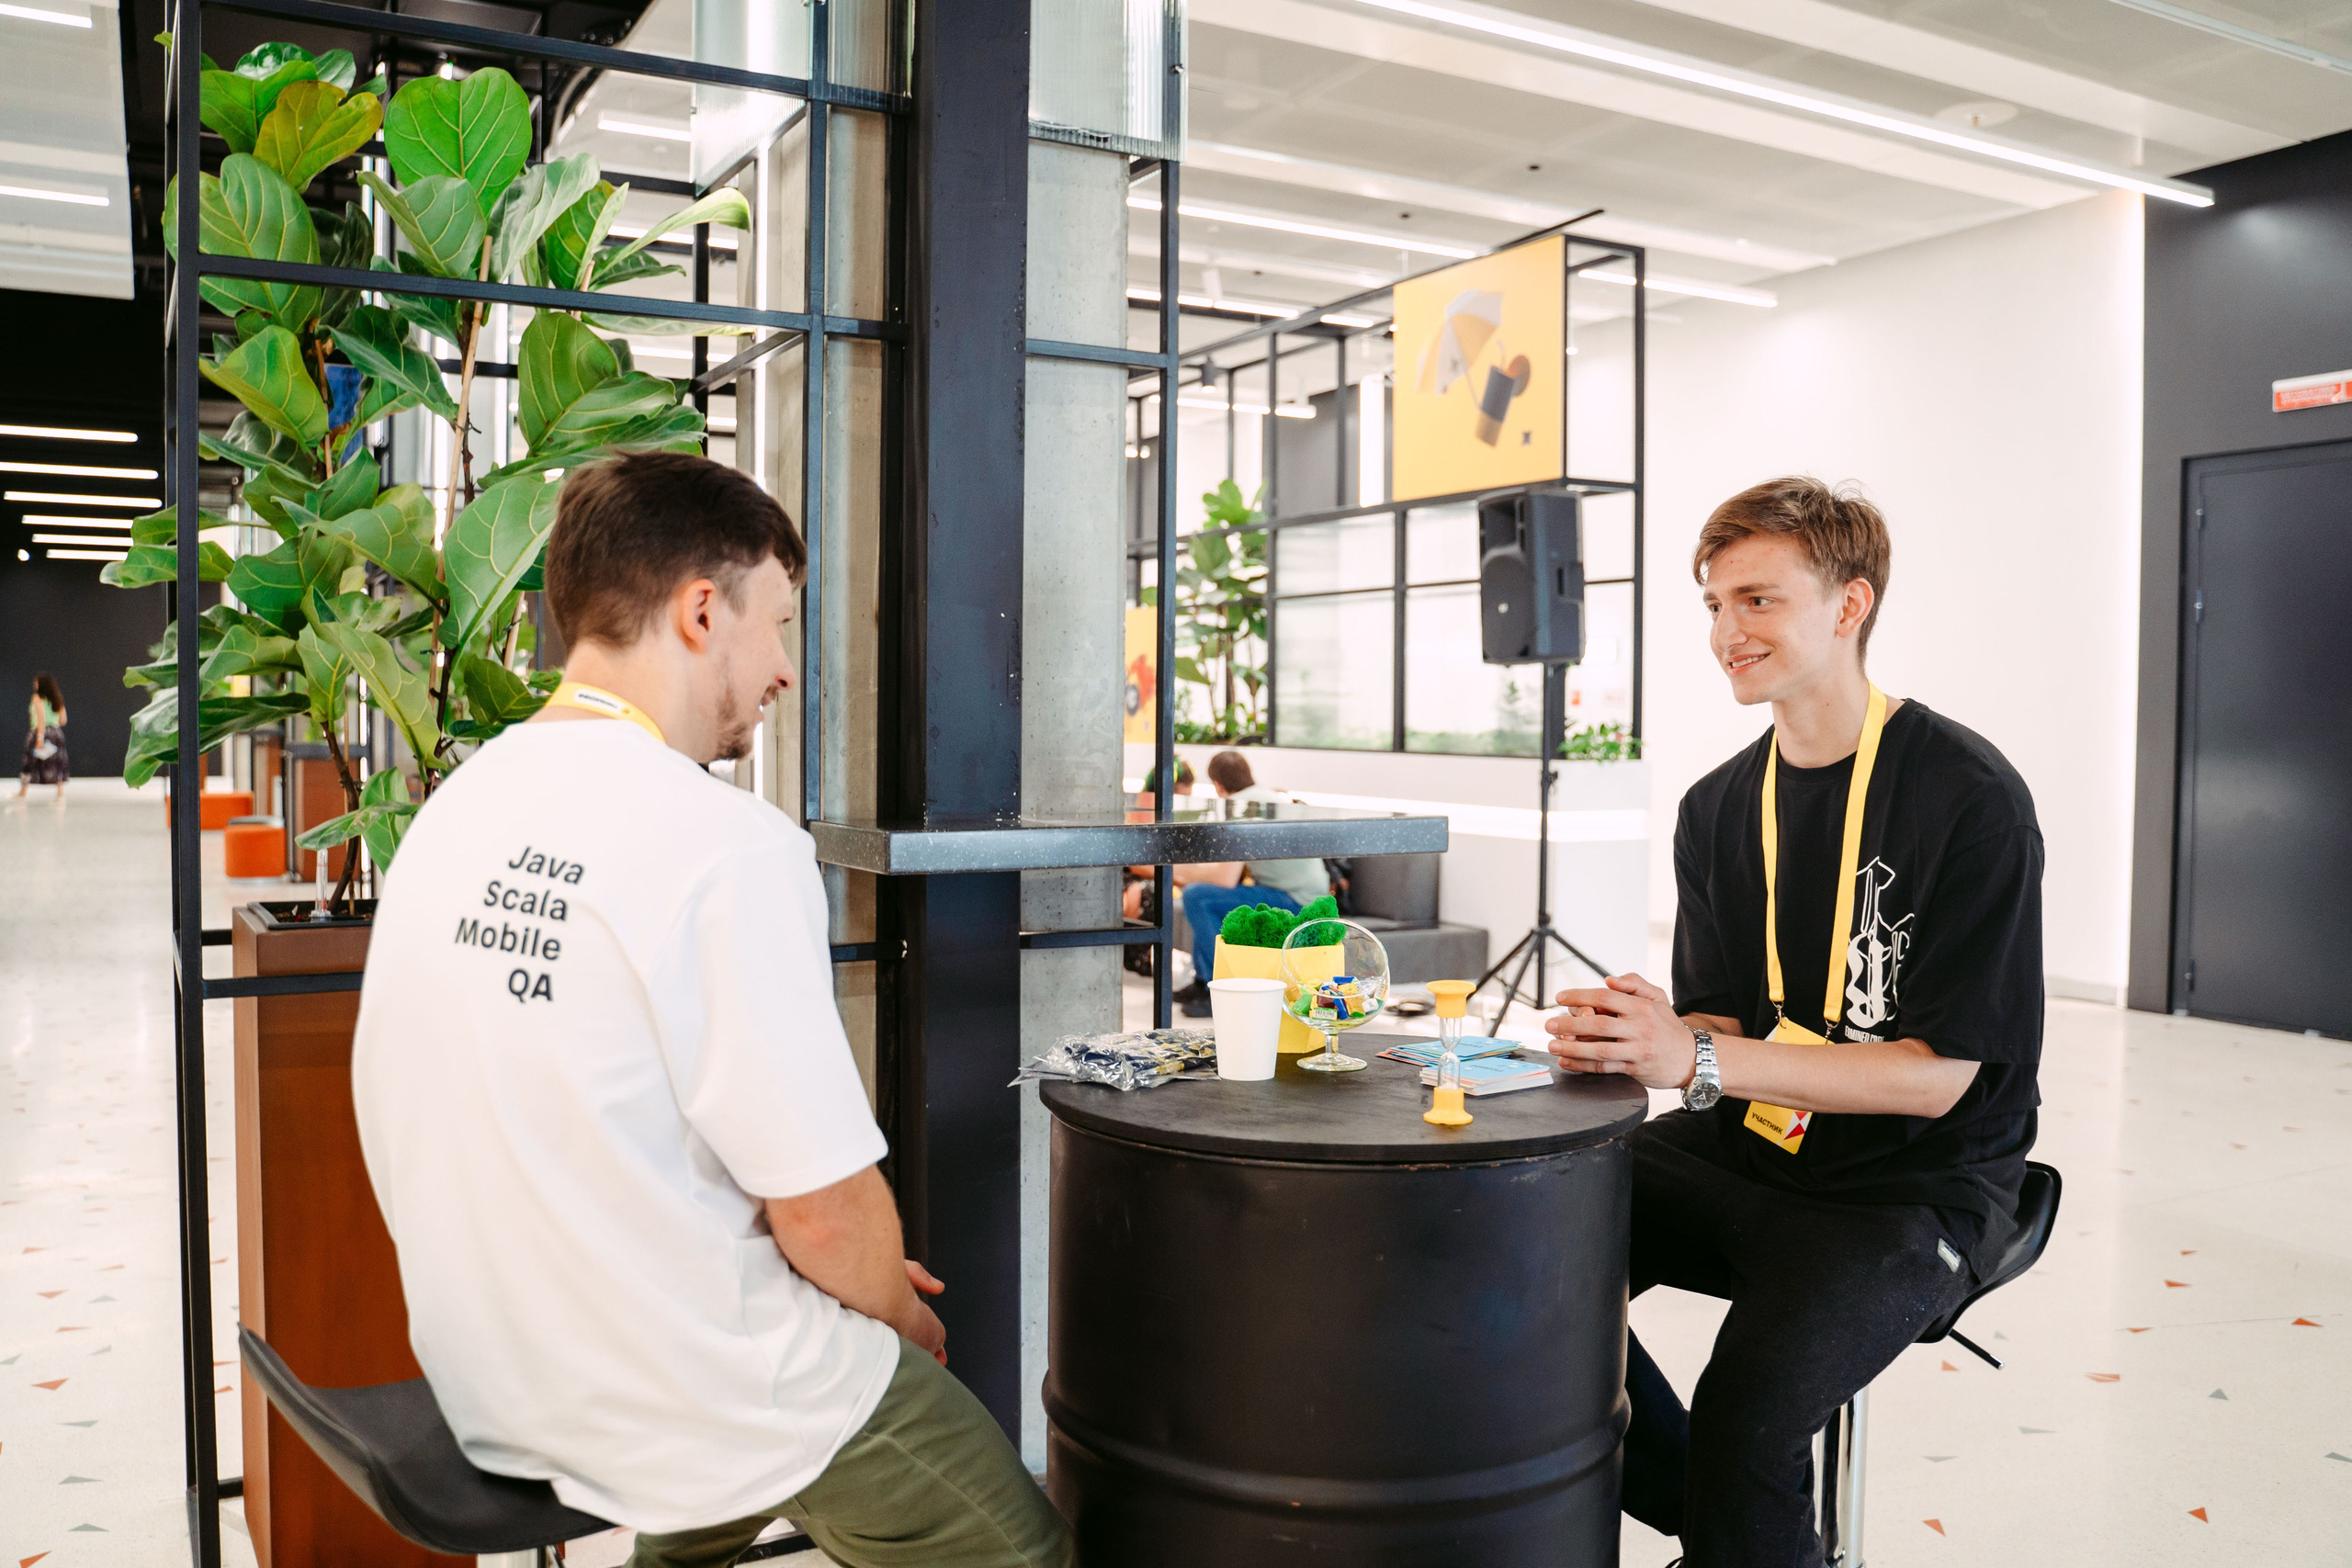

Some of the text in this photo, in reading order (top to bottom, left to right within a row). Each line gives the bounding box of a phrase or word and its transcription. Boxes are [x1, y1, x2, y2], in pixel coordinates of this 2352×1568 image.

[508, 846, 585, 885] Java
[483, 880, 569, 921] Scala
[455, 917, 561, 961] Mobile
[508, 968, 553, 1004] QA
[1751, 1111, 1783, 1134] УЧАСТНИК
